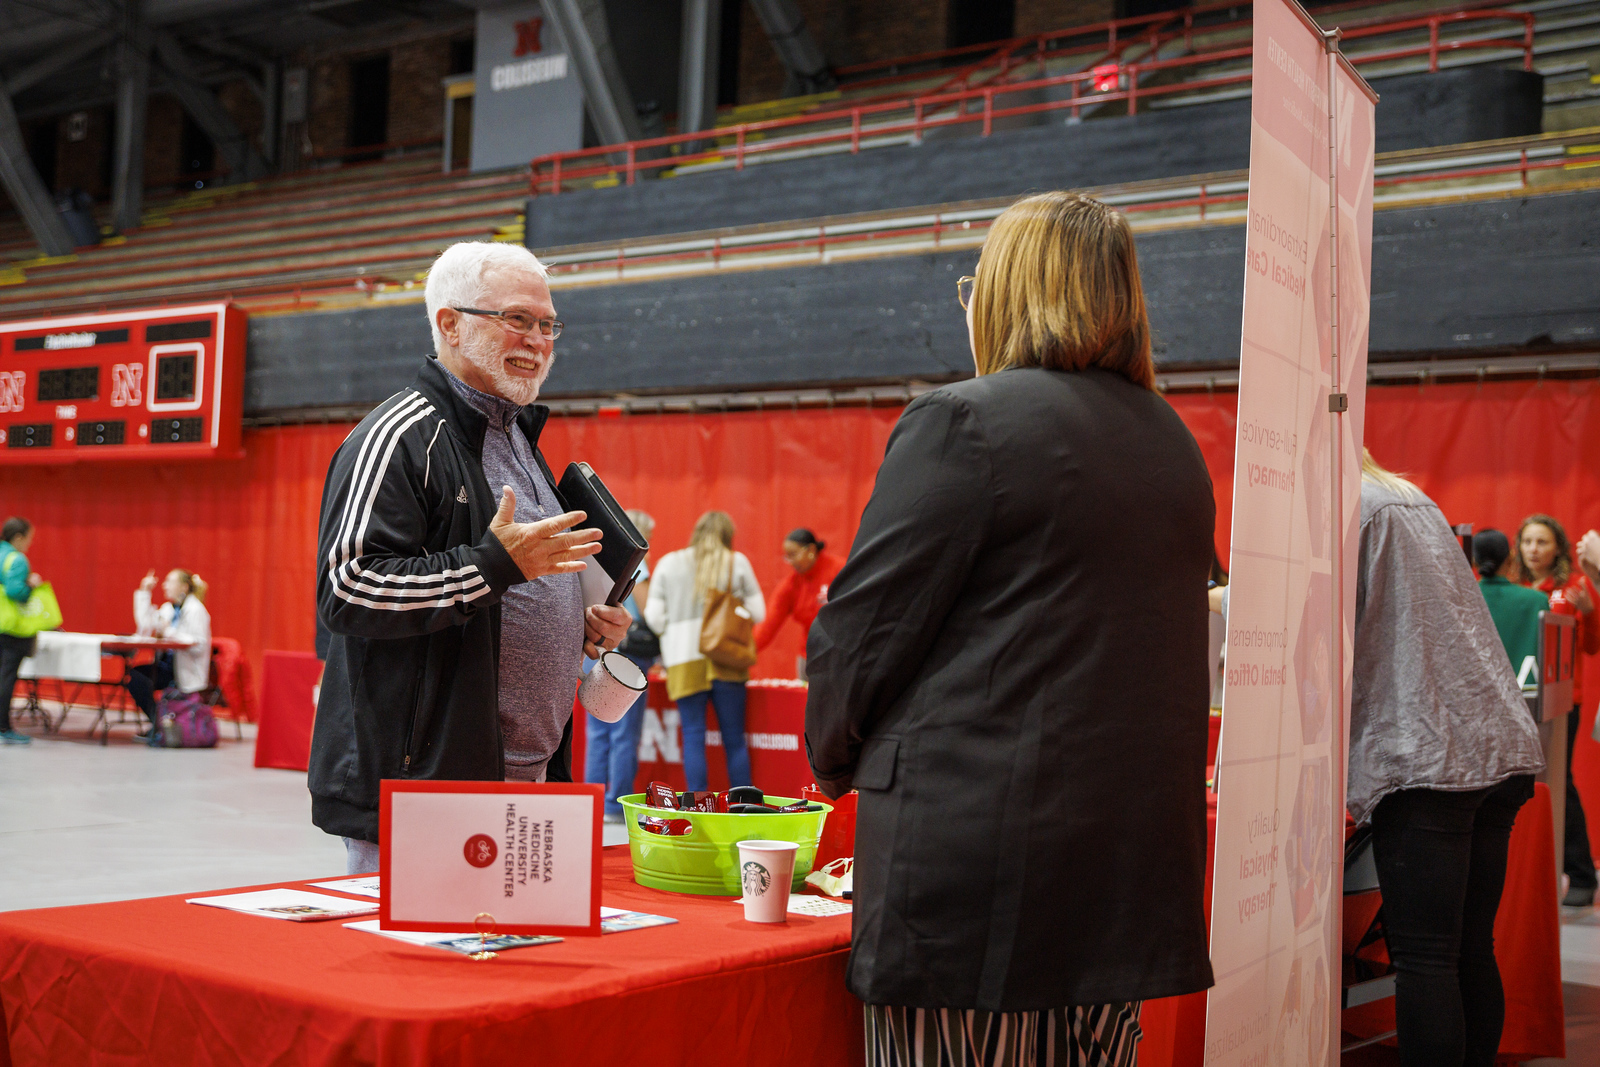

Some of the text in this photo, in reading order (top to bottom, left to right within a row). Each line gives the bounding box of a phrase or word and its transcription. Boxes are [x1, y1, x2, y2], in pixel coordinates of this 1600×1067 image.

[504, 803, 516, 898] HEALTH CENTER
[517, 816, 528, 886] UNIVERSITY
[530, 822, 541, 880] MEDICINE
[543, 819, 554, 883] NEBRASKA
